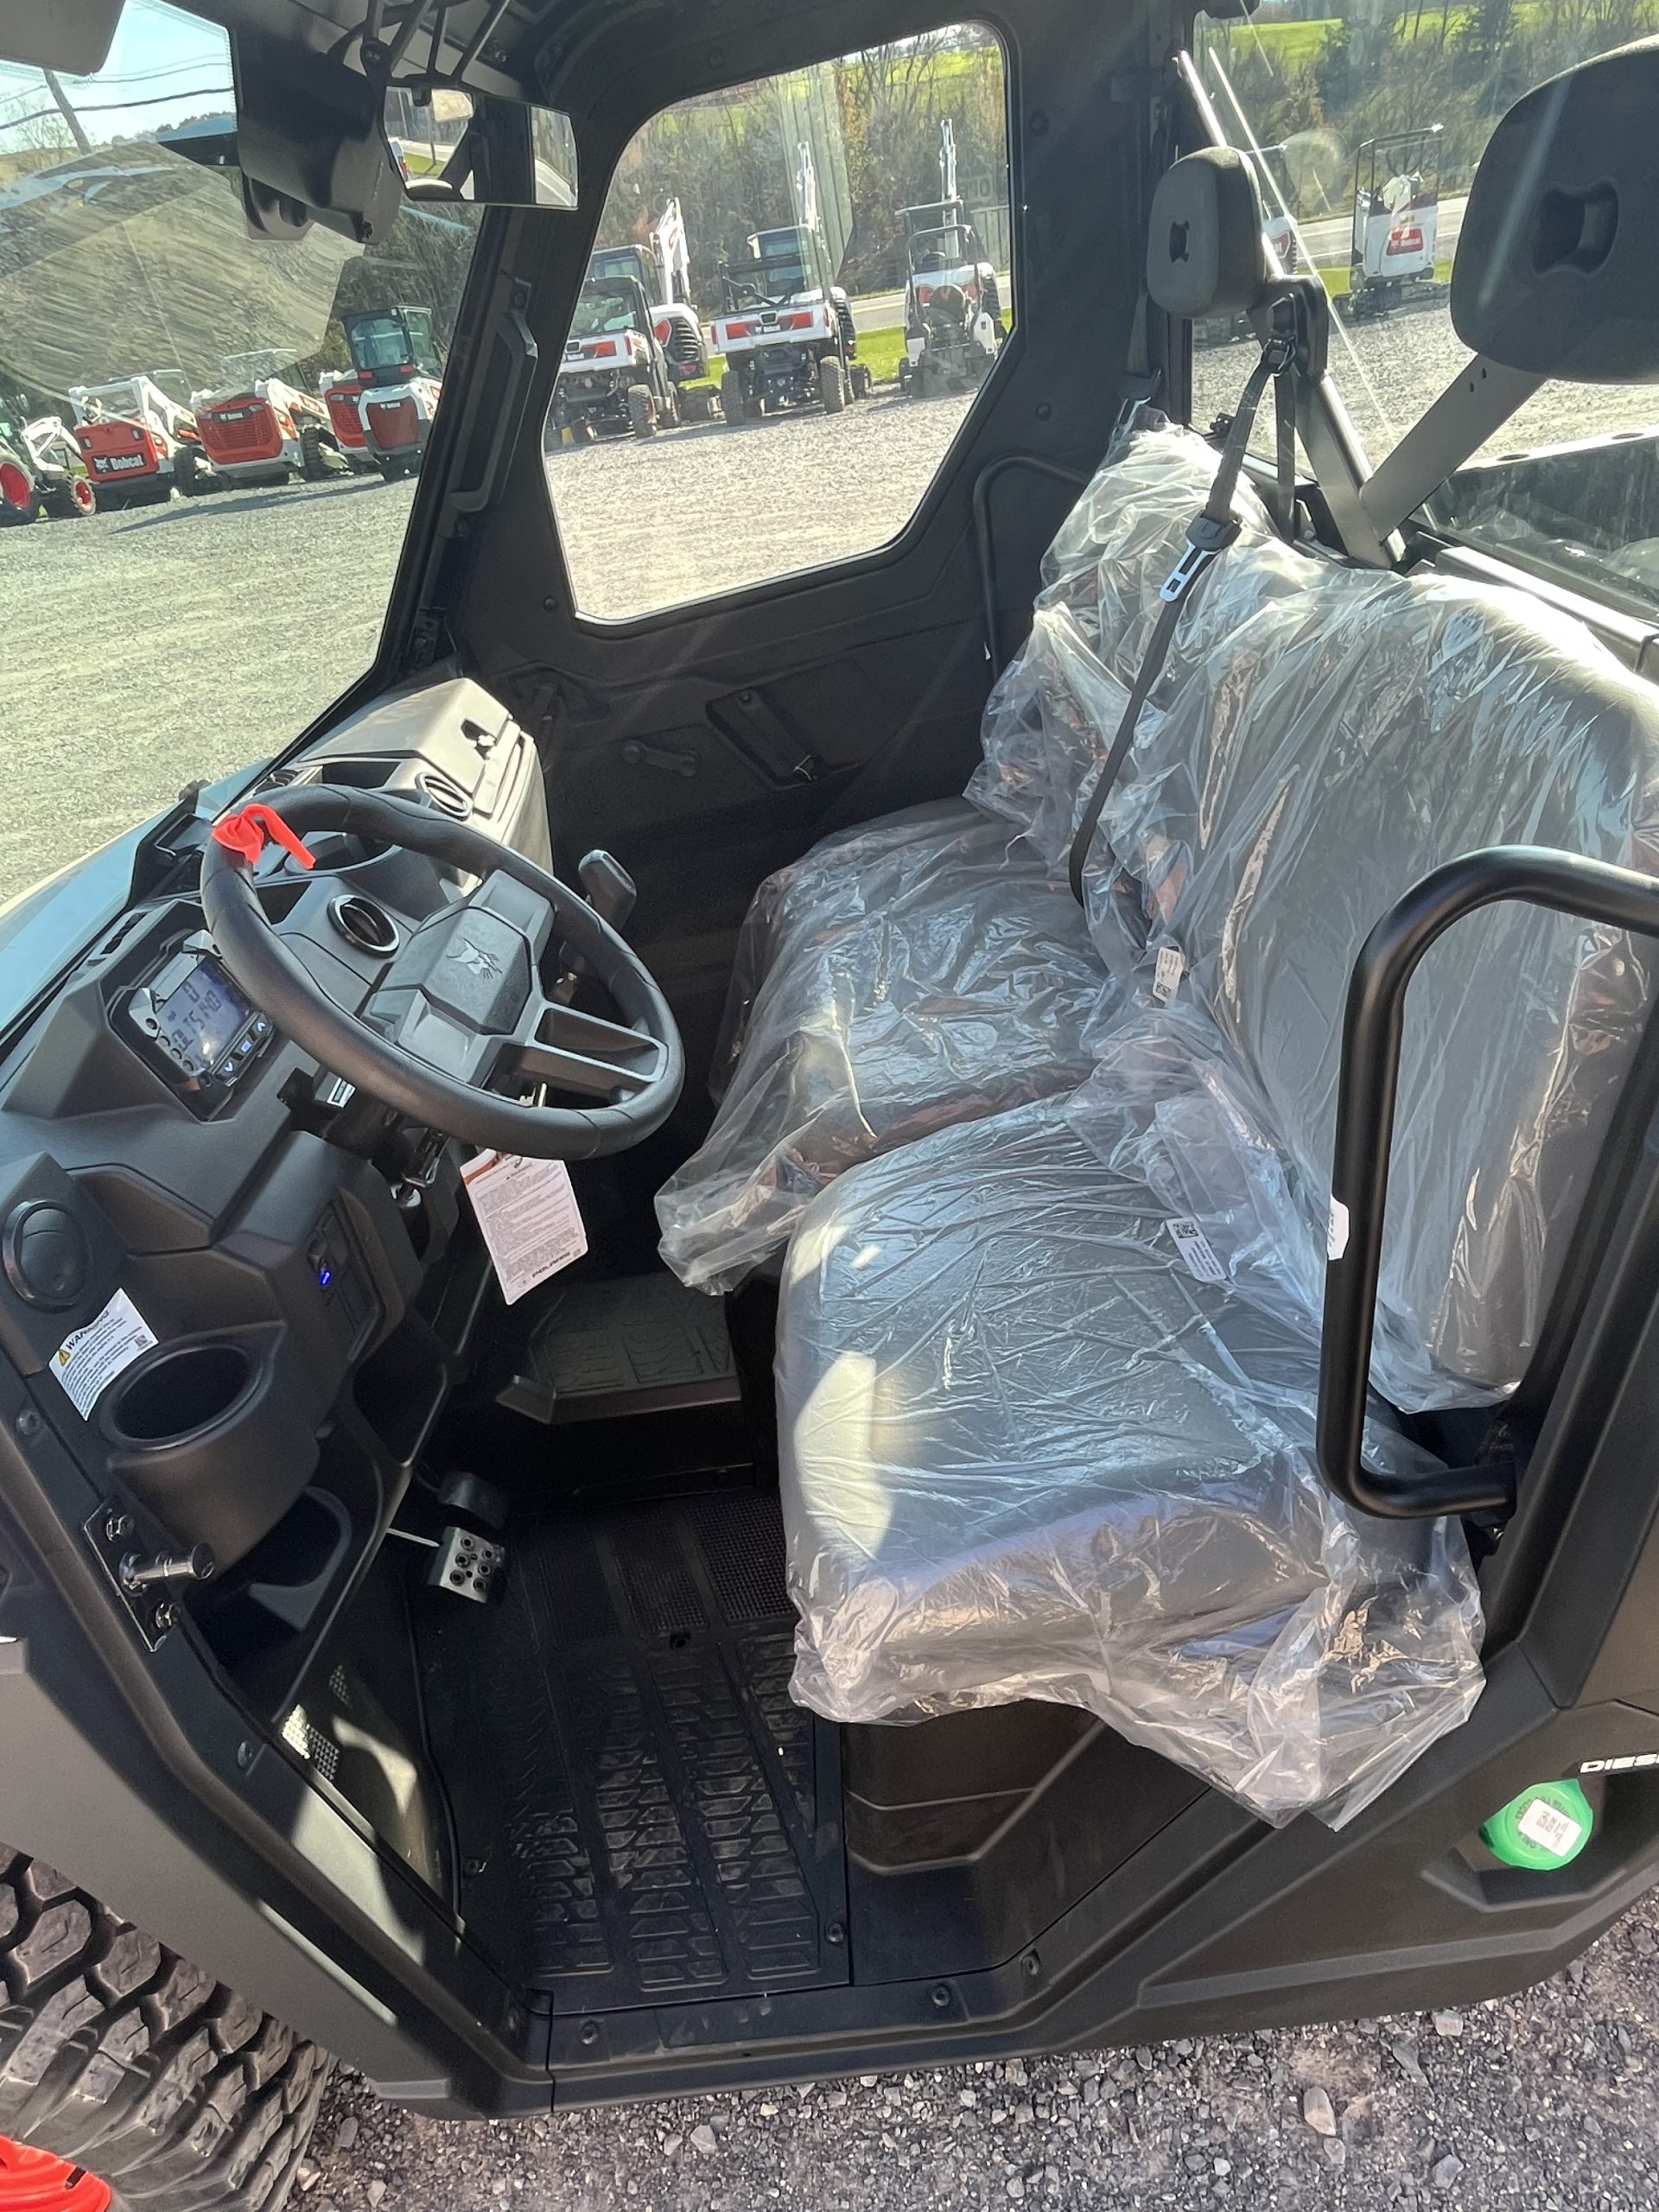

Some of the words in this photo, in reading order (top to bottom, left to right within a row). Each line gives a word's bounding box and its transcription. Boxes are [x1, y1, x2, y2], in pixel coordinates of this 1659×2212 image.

[110, 454, 144, 471] Bobcat
[531, 1251, 571, 1278] POLARIS
[1580, 1753, 1659, 1773] DIES
